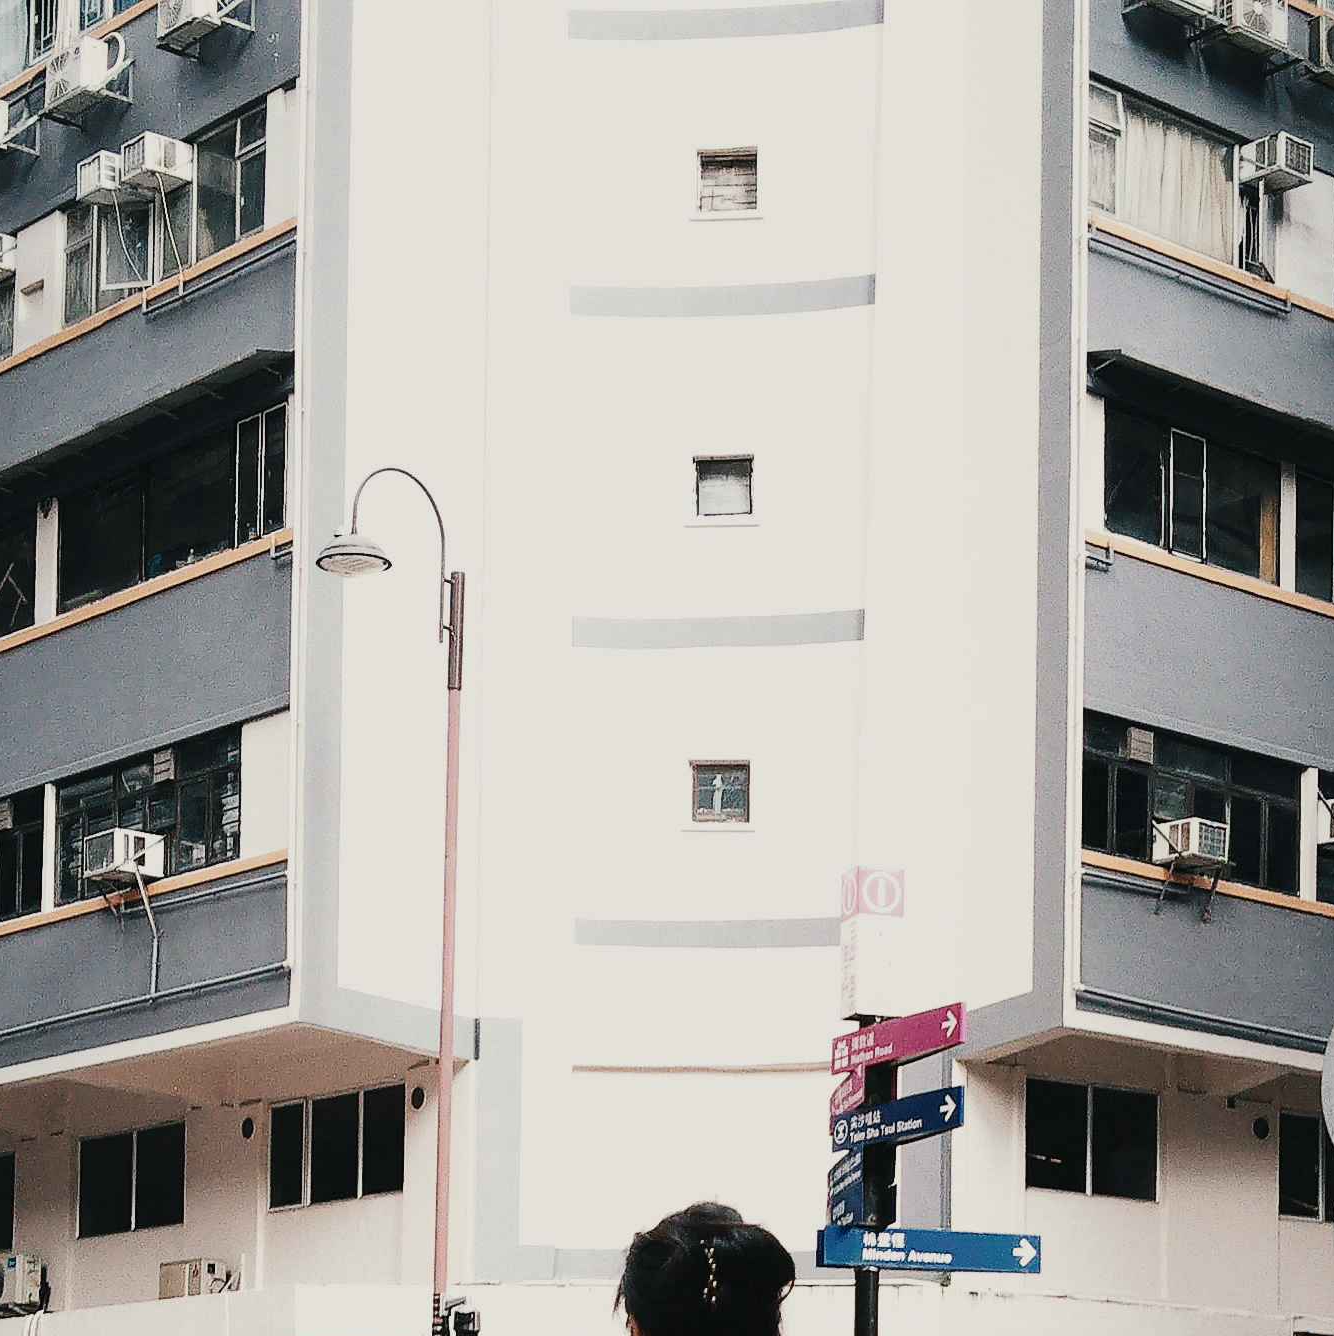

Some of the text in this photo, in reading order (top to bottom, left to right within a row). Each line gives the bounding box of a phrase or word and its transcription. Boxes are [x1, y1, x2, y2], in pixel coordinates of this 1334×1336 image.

[896, 1118, 923, 1133] Station
[862, 1247, 953, 1265] Minden Avenue
